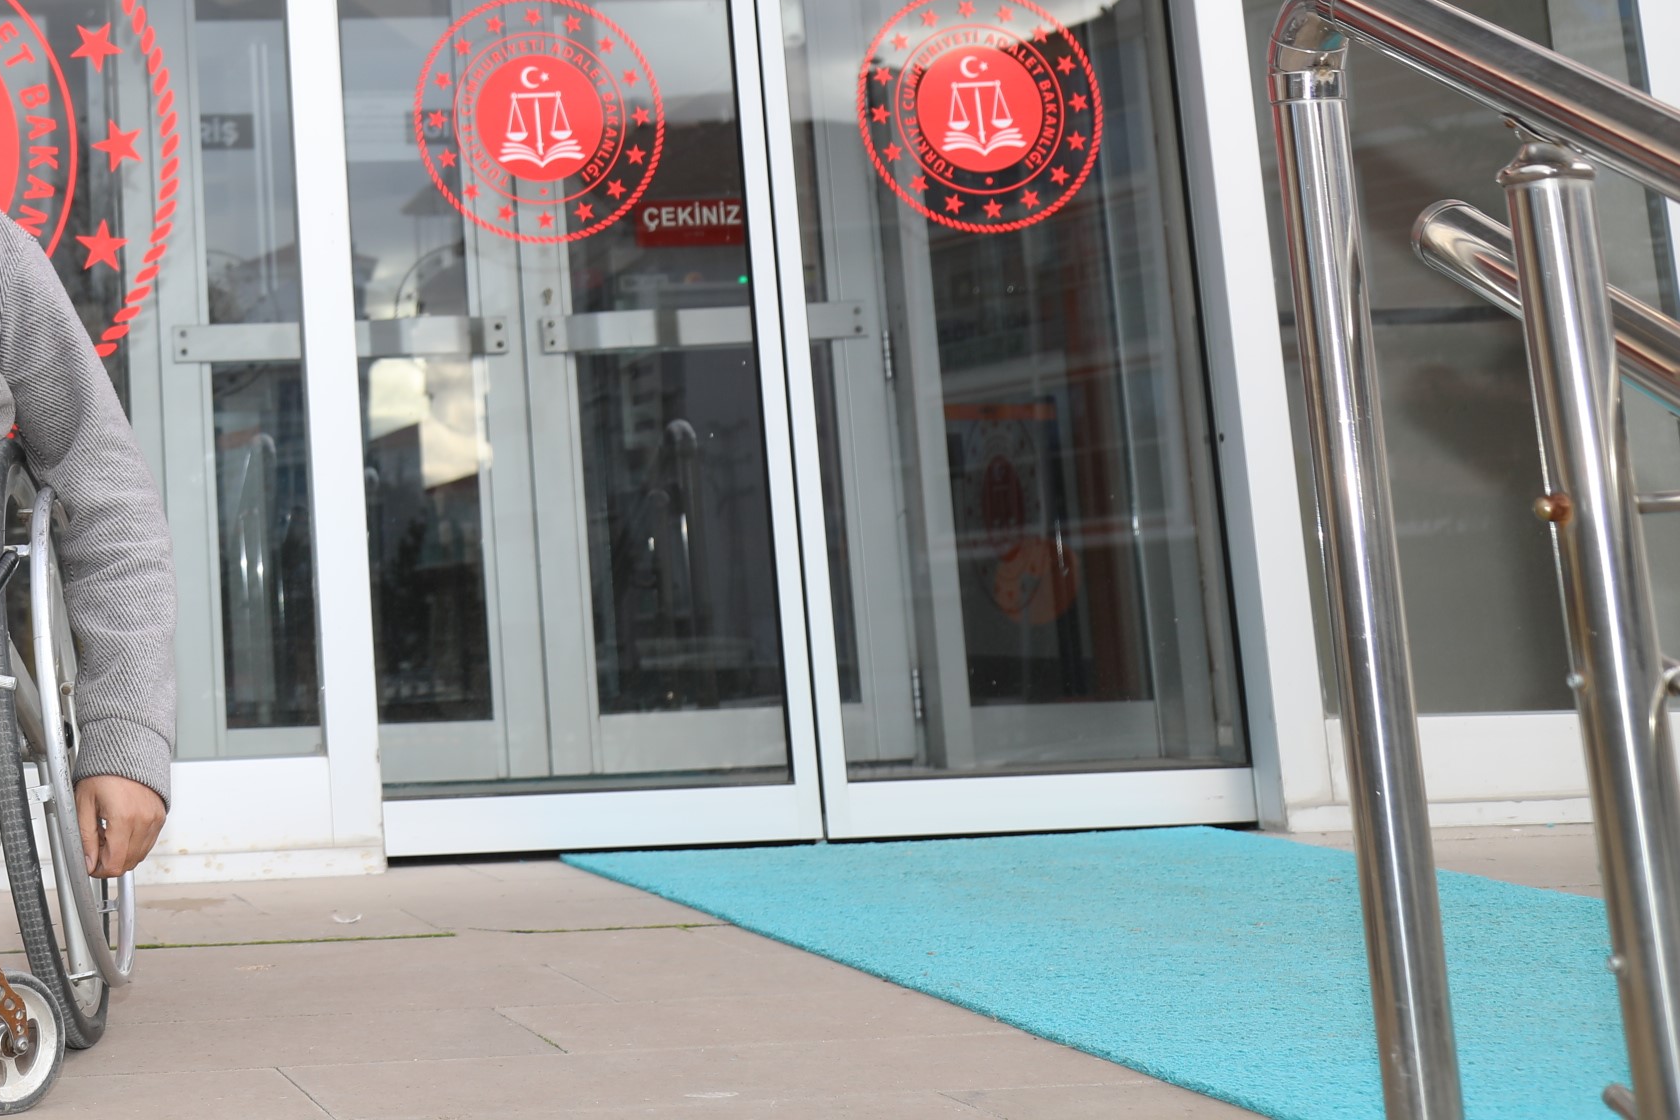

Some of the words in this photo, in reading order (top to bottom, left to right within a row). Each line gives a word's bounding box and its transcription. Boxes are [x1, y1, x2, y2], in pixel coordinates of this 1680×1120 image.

[550, 43, 607, 87] ADALET
[581, 91, 619, 182] BAKANLIĞI
[984, 34, 1044, 76] ADALET
[1024, 80, 1057, 170] BAKANLIĞI
[642, 201, 742, 232] ÇEKİNİZ
